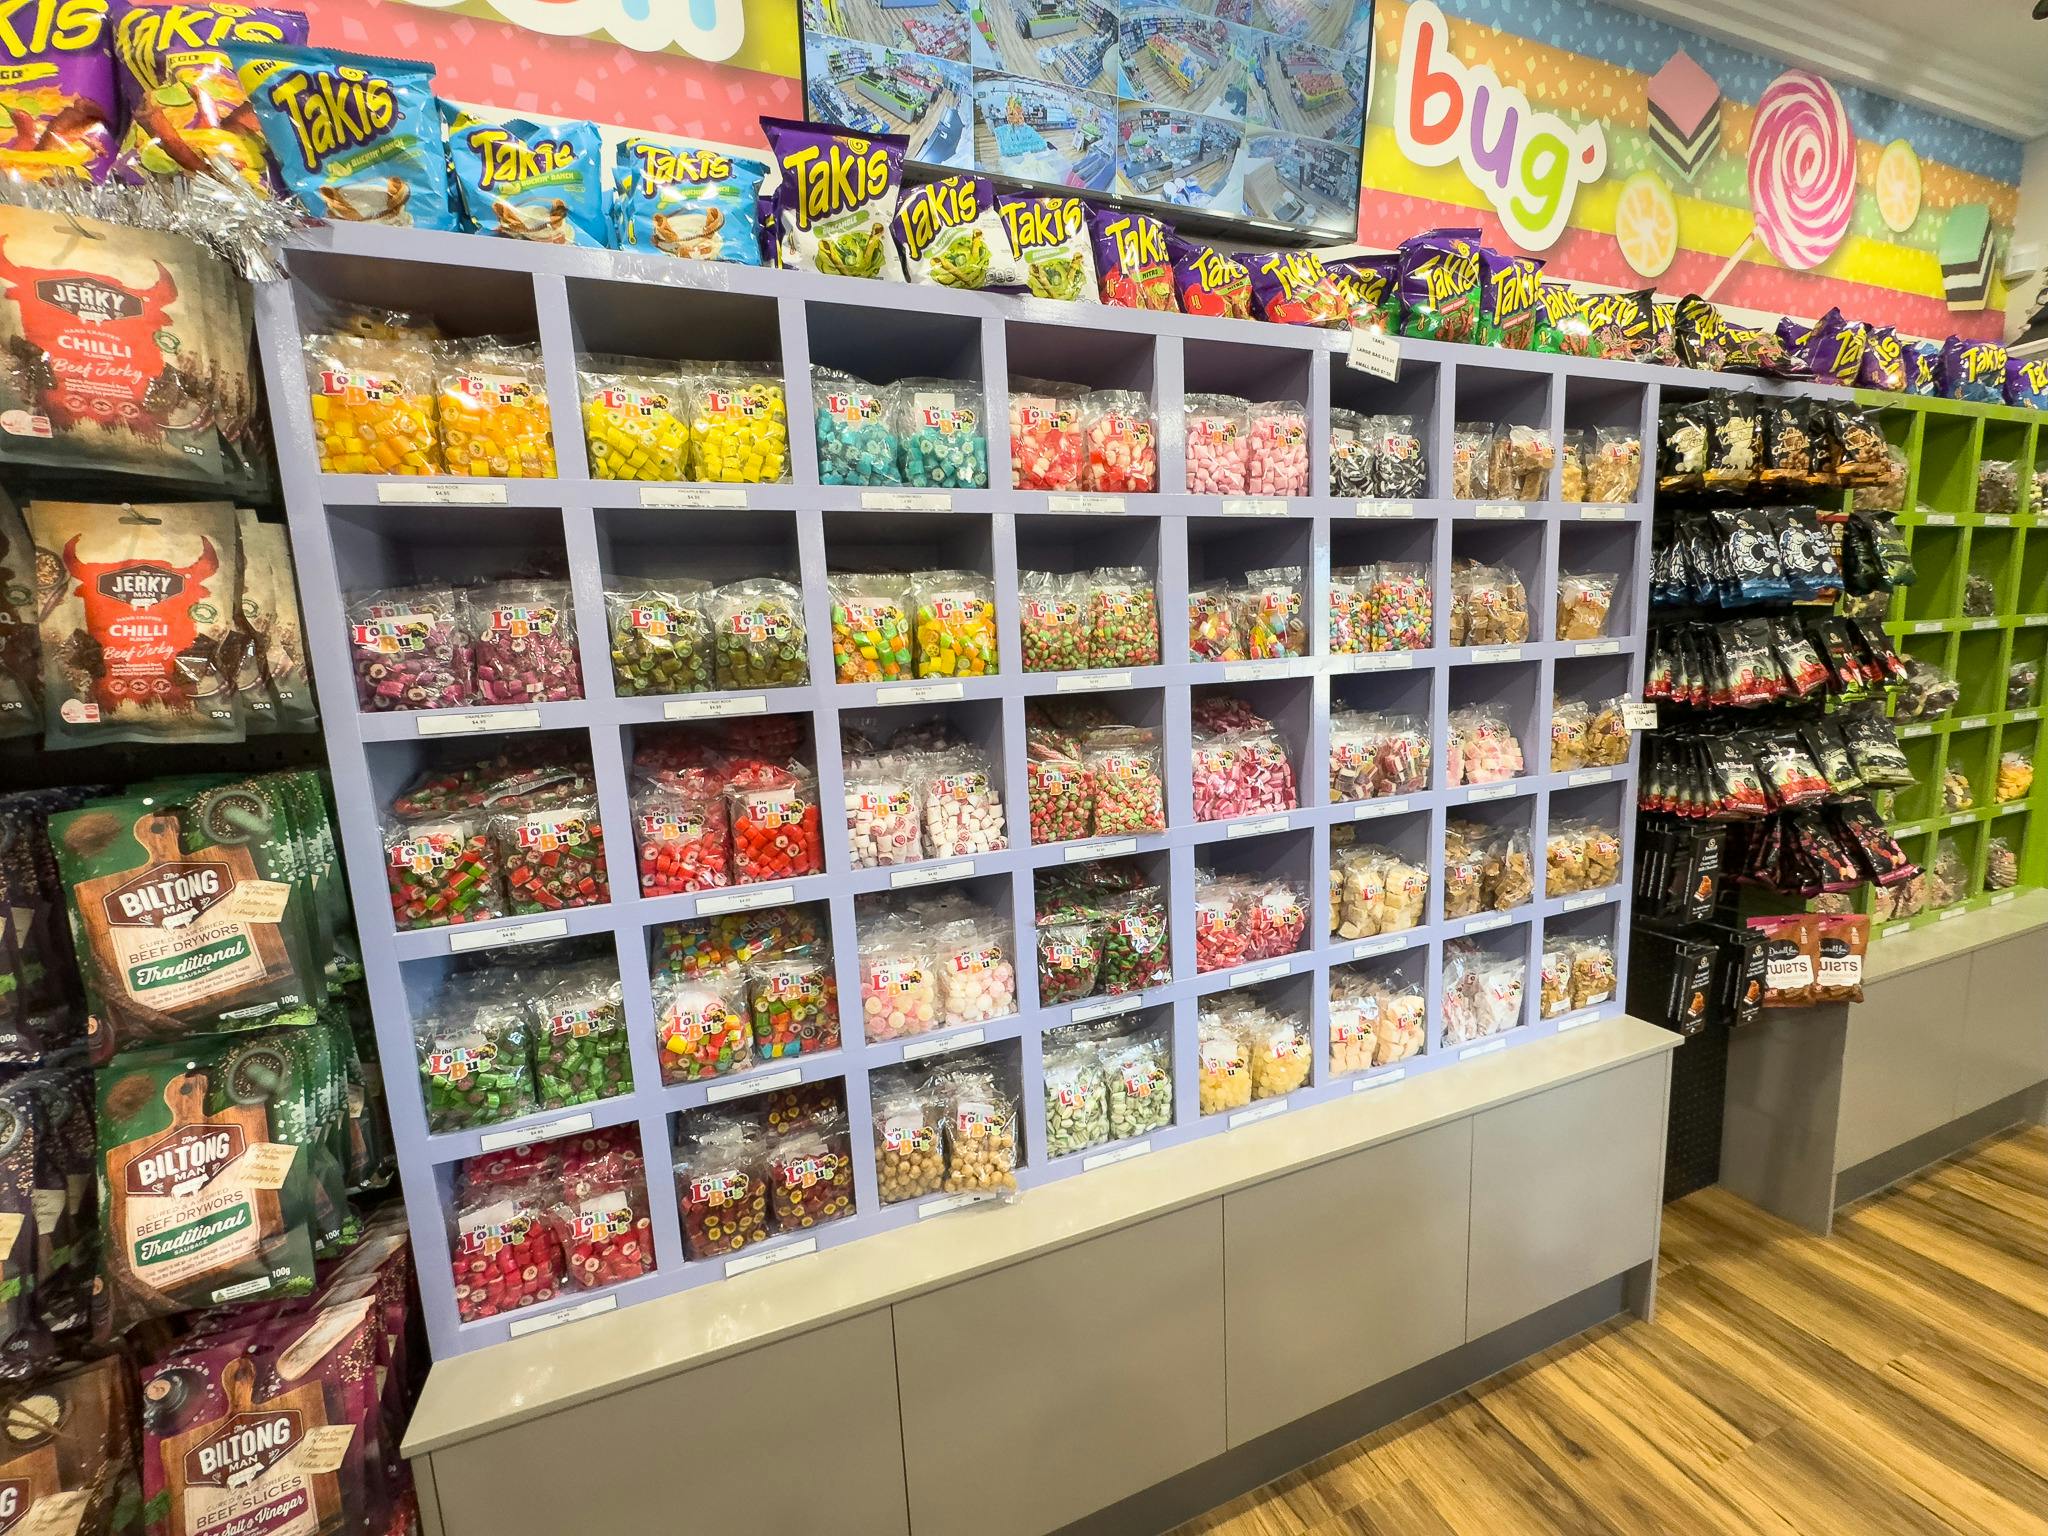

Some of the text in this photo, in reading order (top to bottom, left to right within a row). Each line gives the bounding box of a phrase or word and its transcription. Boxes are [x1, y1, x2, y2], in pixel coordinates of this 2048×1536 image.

[117, 3, 283, 88] Takis
[254, 59, 277, 75] NEW
[272, 67, 394, 169] Takis
[1410, 22, 1569, 231] bug
[380, 138, 404, 155] RANCH
[471, 131, 576, 187] Takis
[551, 172, 574, 181] RANCH
[636, 145, 731, 196] Takis
[783, 138, 888, 228] Takis
[896, 175, 977, 258] Takis
[1000, 198, 1082, 261] Takis
[1265, 251, 1326, 300] Takis
[1426, 250, 1479, 312] Takis
[53, 283, 125, 311] JERKY
[1491, 262, 1542, 325] Takis
[80, 304, 107, 313] MAN
[57, 335, 131, 358] CHILLI
[1356, 346, 1372, 356] LARGE
[1372, 337, 1386, 346] TAKIS
[52, 358, 143, 386] Beef Jerky
[1355, 360, 1370, 370] SMALL
[1371, 365, 1381, 373] BAG
[112, 576, 172, 593] JERKY
[109, 624, 168, 637] CHILLI
[104, 641, 174, 662] Beef Jerky
[1, 702, 14, 711] 50
[212, 710, 223, 718] 50
[253, 702, 263, 710] 50
[163, 871, 180, 881] The
[119, 869, 220, 917] BILTONG
[163, 900, 194, 915] MAN
[130, 923, 239, 964] BEEF DRYWORS
[139, 937, 175, 950] CURED
[199, 920, 225, 932] DRIED
[136, 941, 245, 986] Traditional
[178, 966, 213, 980] SAUSAGE
[280, 995, 299, 1005] 100g
[182, 1135, 198, 1145] The
[138, 1132, 230, 1187] BILTONG
[174, 1166, 206, 1181] MAN
[136, 1190, 243, 1237] BEEF DRYWORS
[141, 1209, 246, 1261] Traditional
[174, 1239, 208, 1256] SAUSAGE
[272, 1267, 291, 1279] 100g
[199, 1417, 291, 1475] BILTONG
[229, 1454, 259, 1472] MAN
[196, 1476, 302, 1529] BEEF SLICES
[226, 1520, 246, 1535] Salt
[255, 1494, 305, 1523] Vinegar
